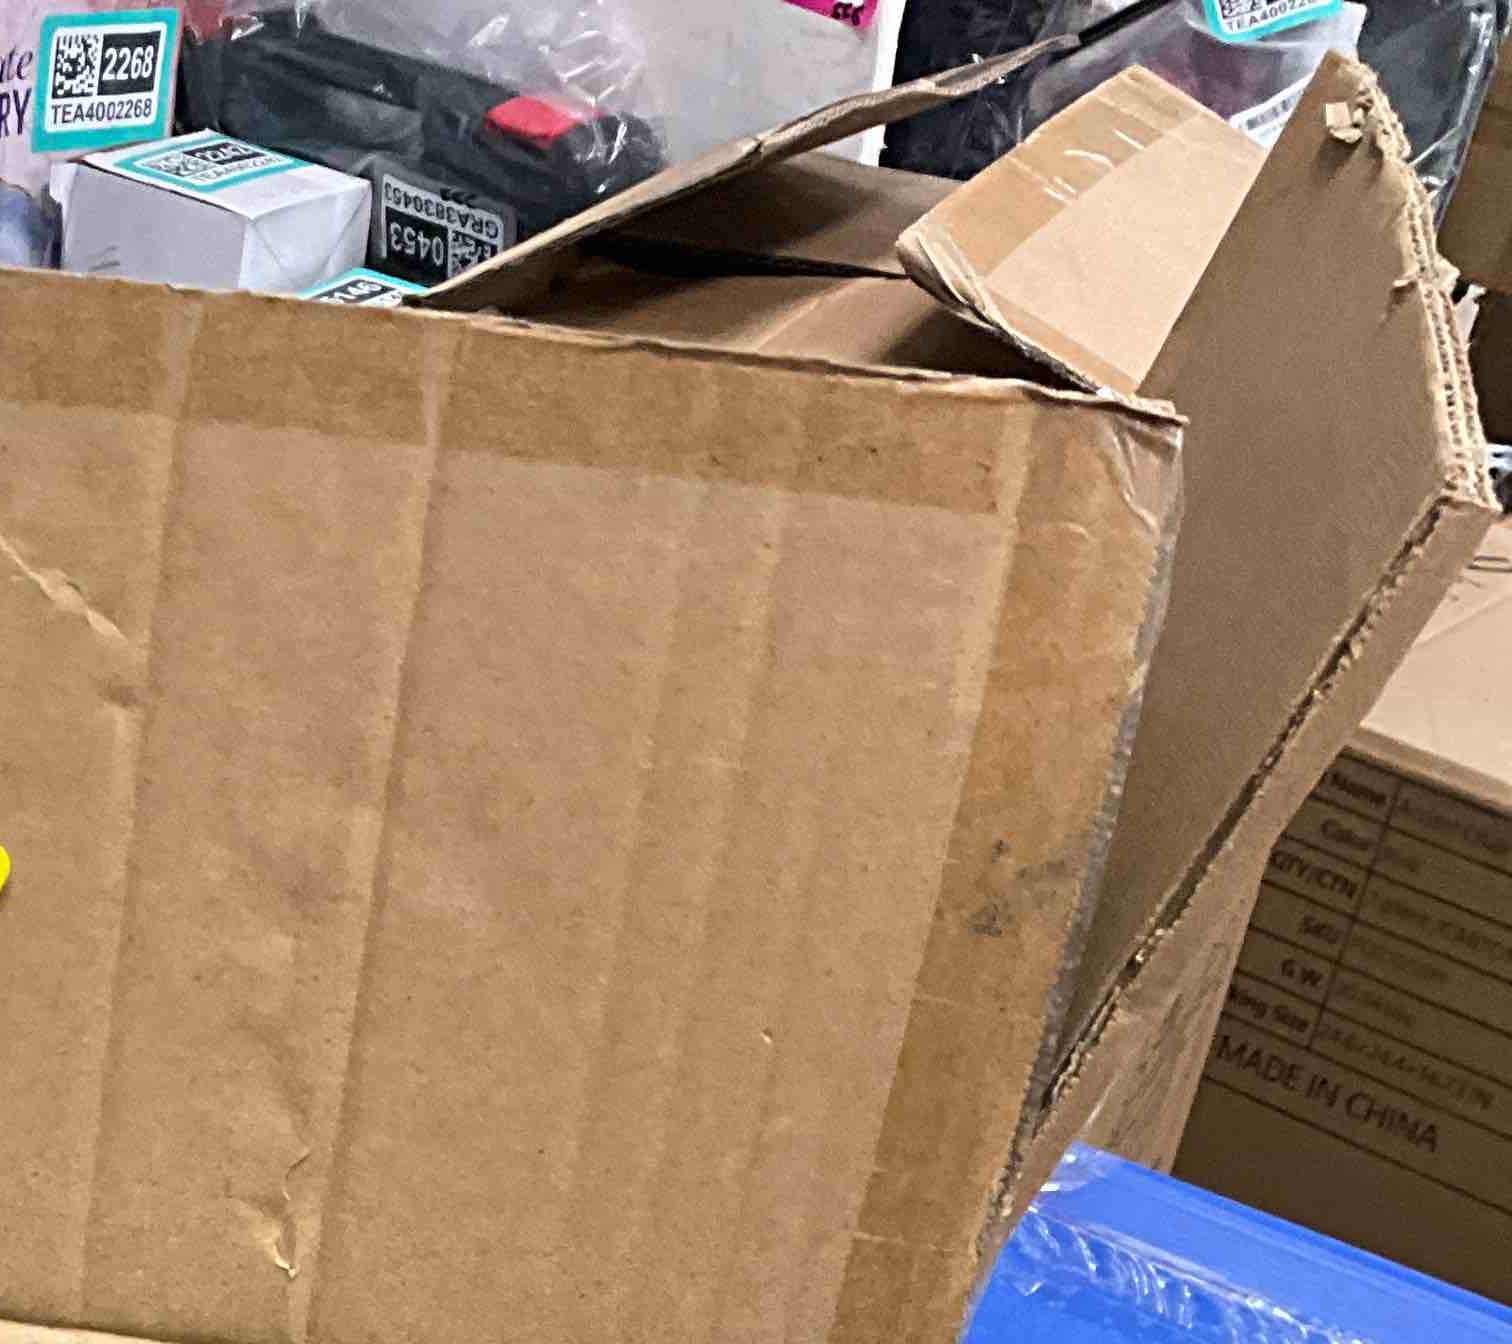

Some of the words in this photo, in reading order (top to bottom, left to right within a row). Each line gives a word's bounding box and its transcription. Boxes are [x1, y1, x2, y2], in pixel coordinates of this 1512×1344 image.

[102, 45, 154, 82] 2268
[50, 97, 153, 126] TEA4002268
[389, 221, 445, 267] 0453
[1219, 1034, 1298, 1090] MADE
[1305, 1071, 1341, 1108] IN
[1343, 1088, 1440, 1155] CHINA
